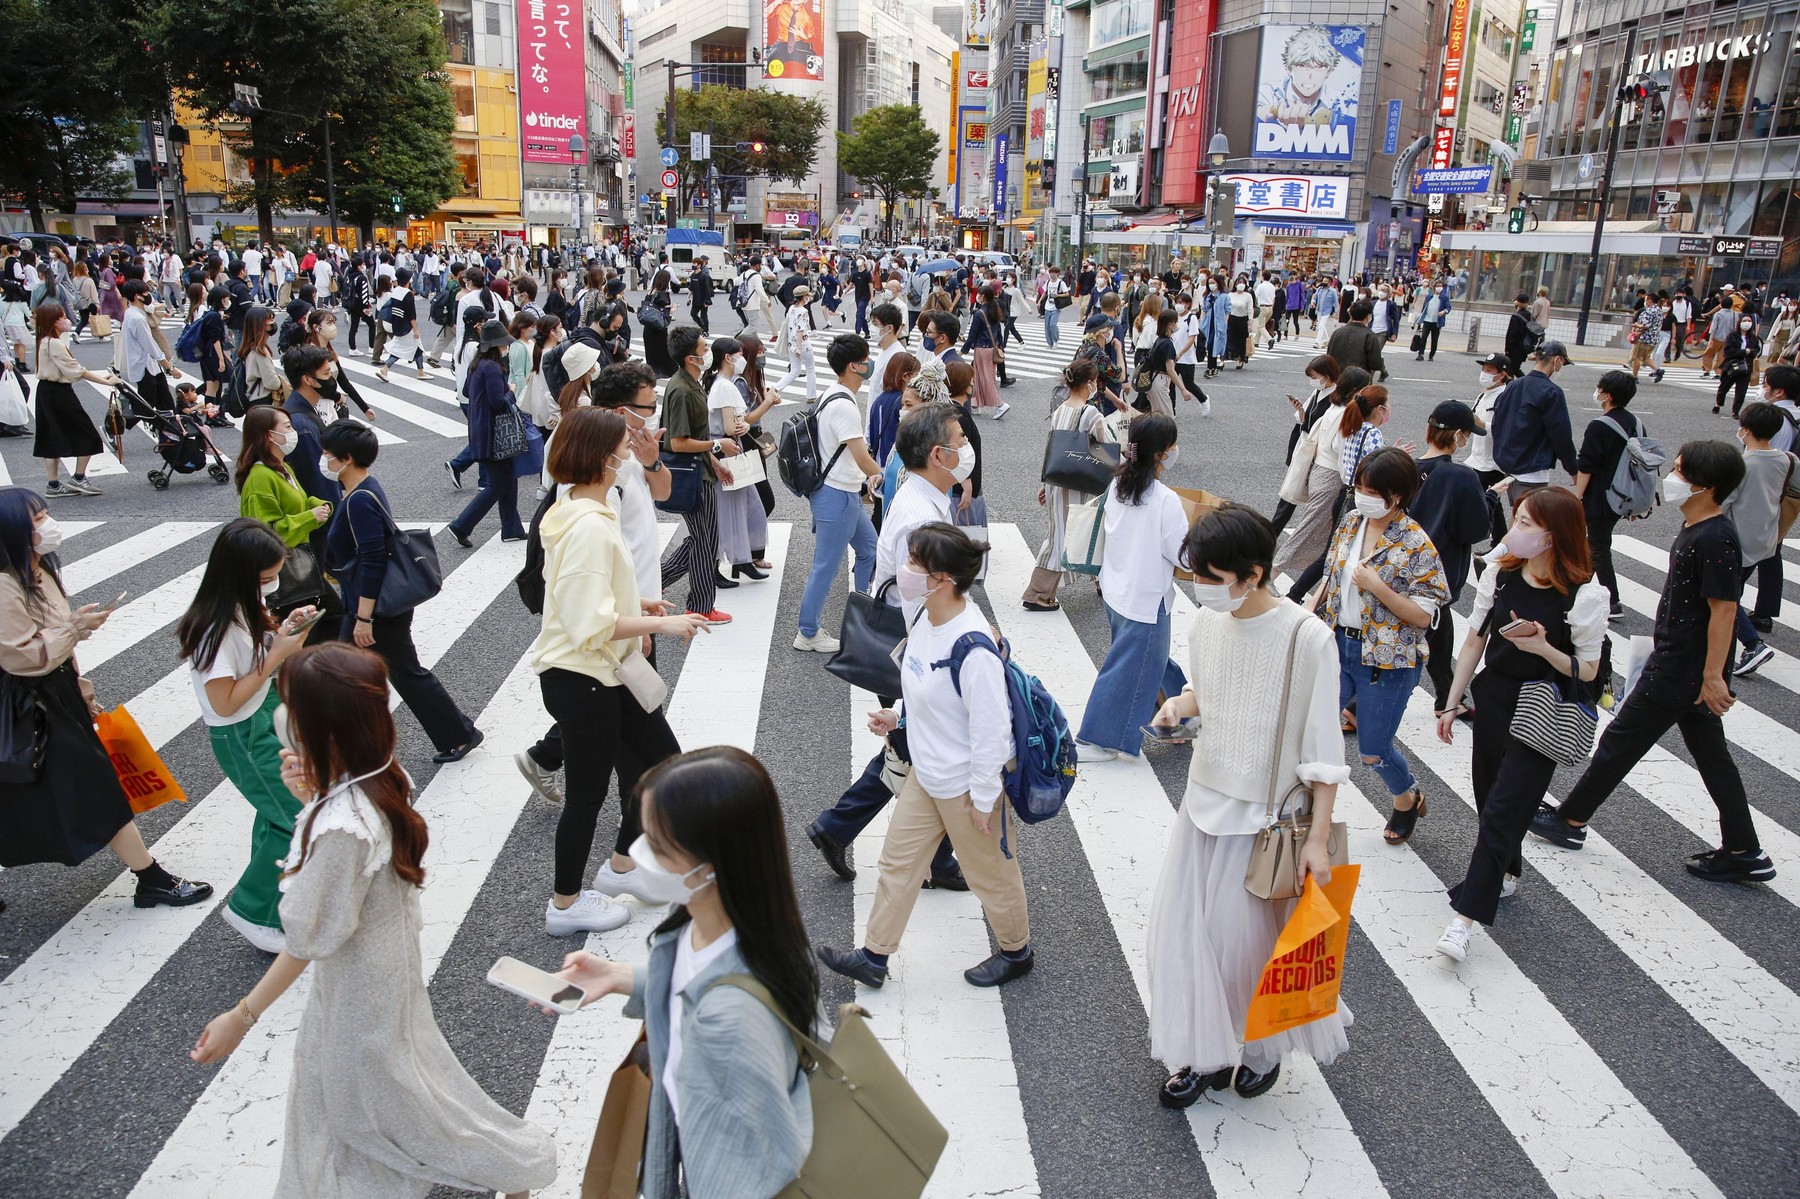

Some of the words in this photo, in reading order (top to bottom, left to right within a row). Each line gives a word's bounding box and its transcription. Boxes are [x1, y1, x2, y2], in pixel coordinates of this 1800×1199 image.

[1629, 31, 1774, 75] TARBUCKS
[1441, 58, 1461, 110] 三千里
[538, 112, 579, 130] tinder
[970, 124, 986, 139] 薬
[1256, 123, 1350, 154] DMM
[1235, 182, 1337, 208] 堂書店
